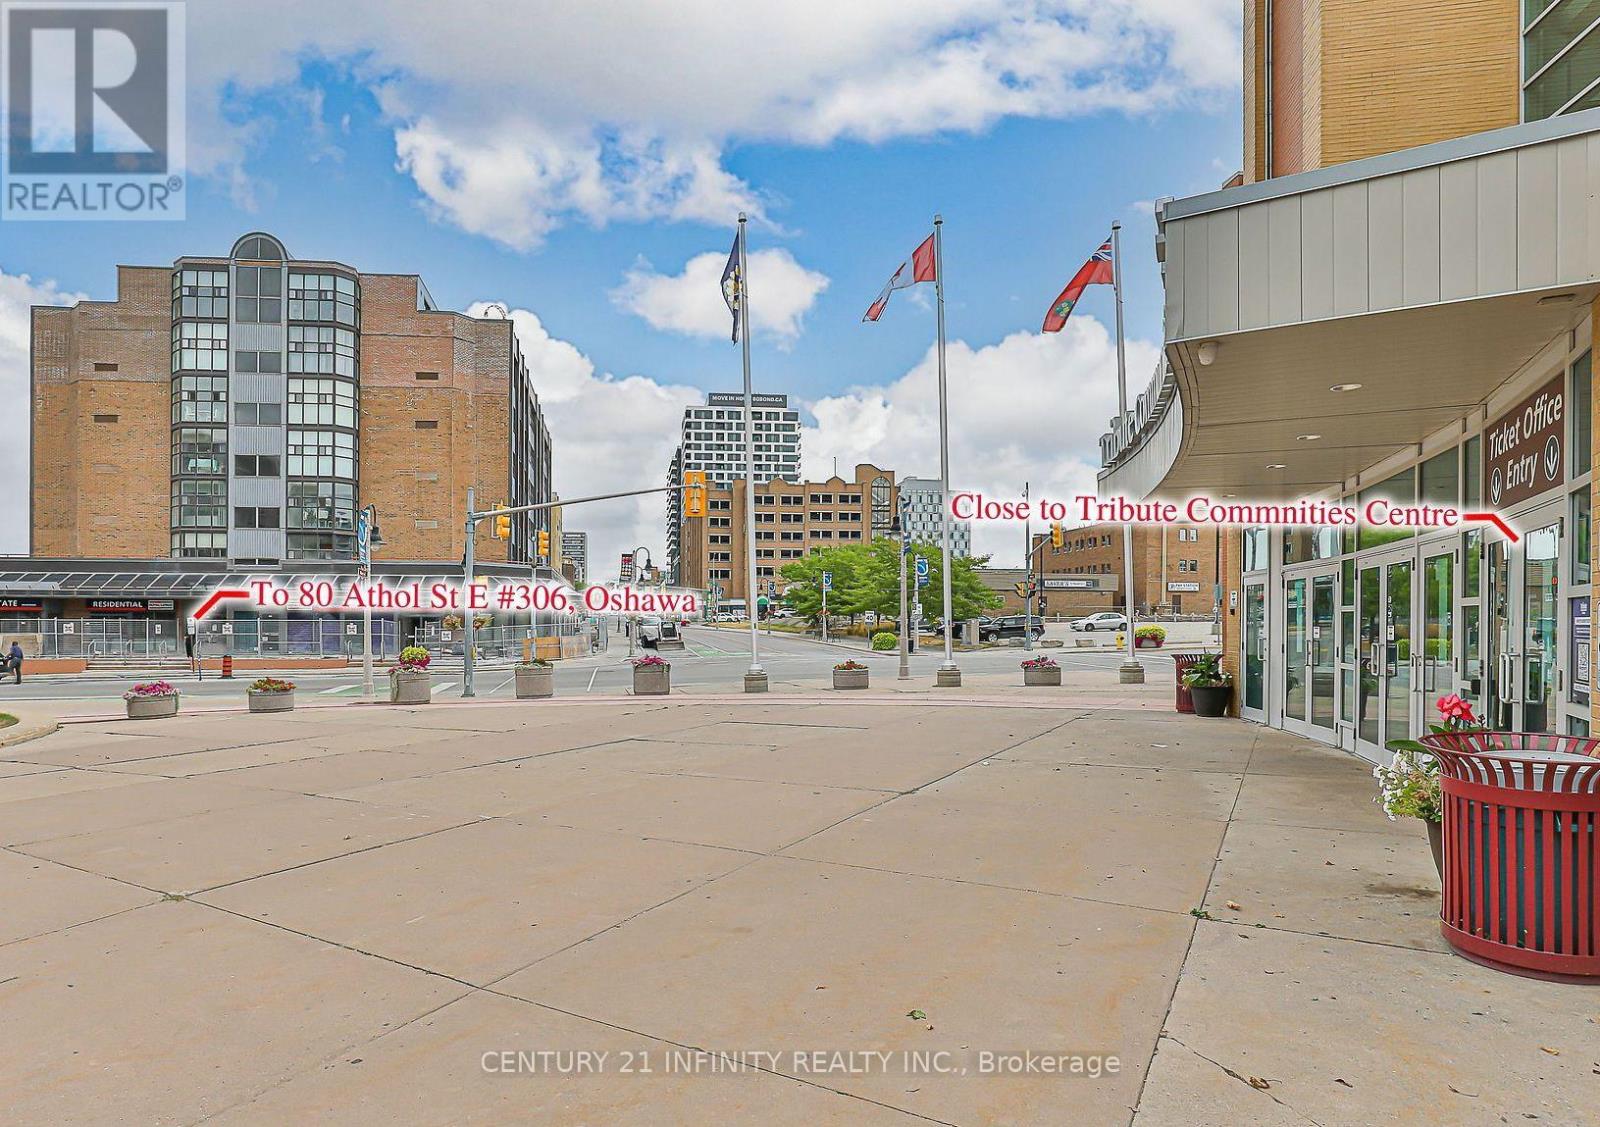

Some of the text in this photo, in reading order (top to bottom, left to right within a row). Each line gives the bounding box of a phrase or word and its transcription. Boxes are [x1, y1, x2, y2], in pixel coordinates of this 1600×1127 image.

[1490, 393, 1563, 461] Ticket Office
[1506, 452, 1539, 490] Entry
[92, 600, 143, 608] RESIDENTIAL
